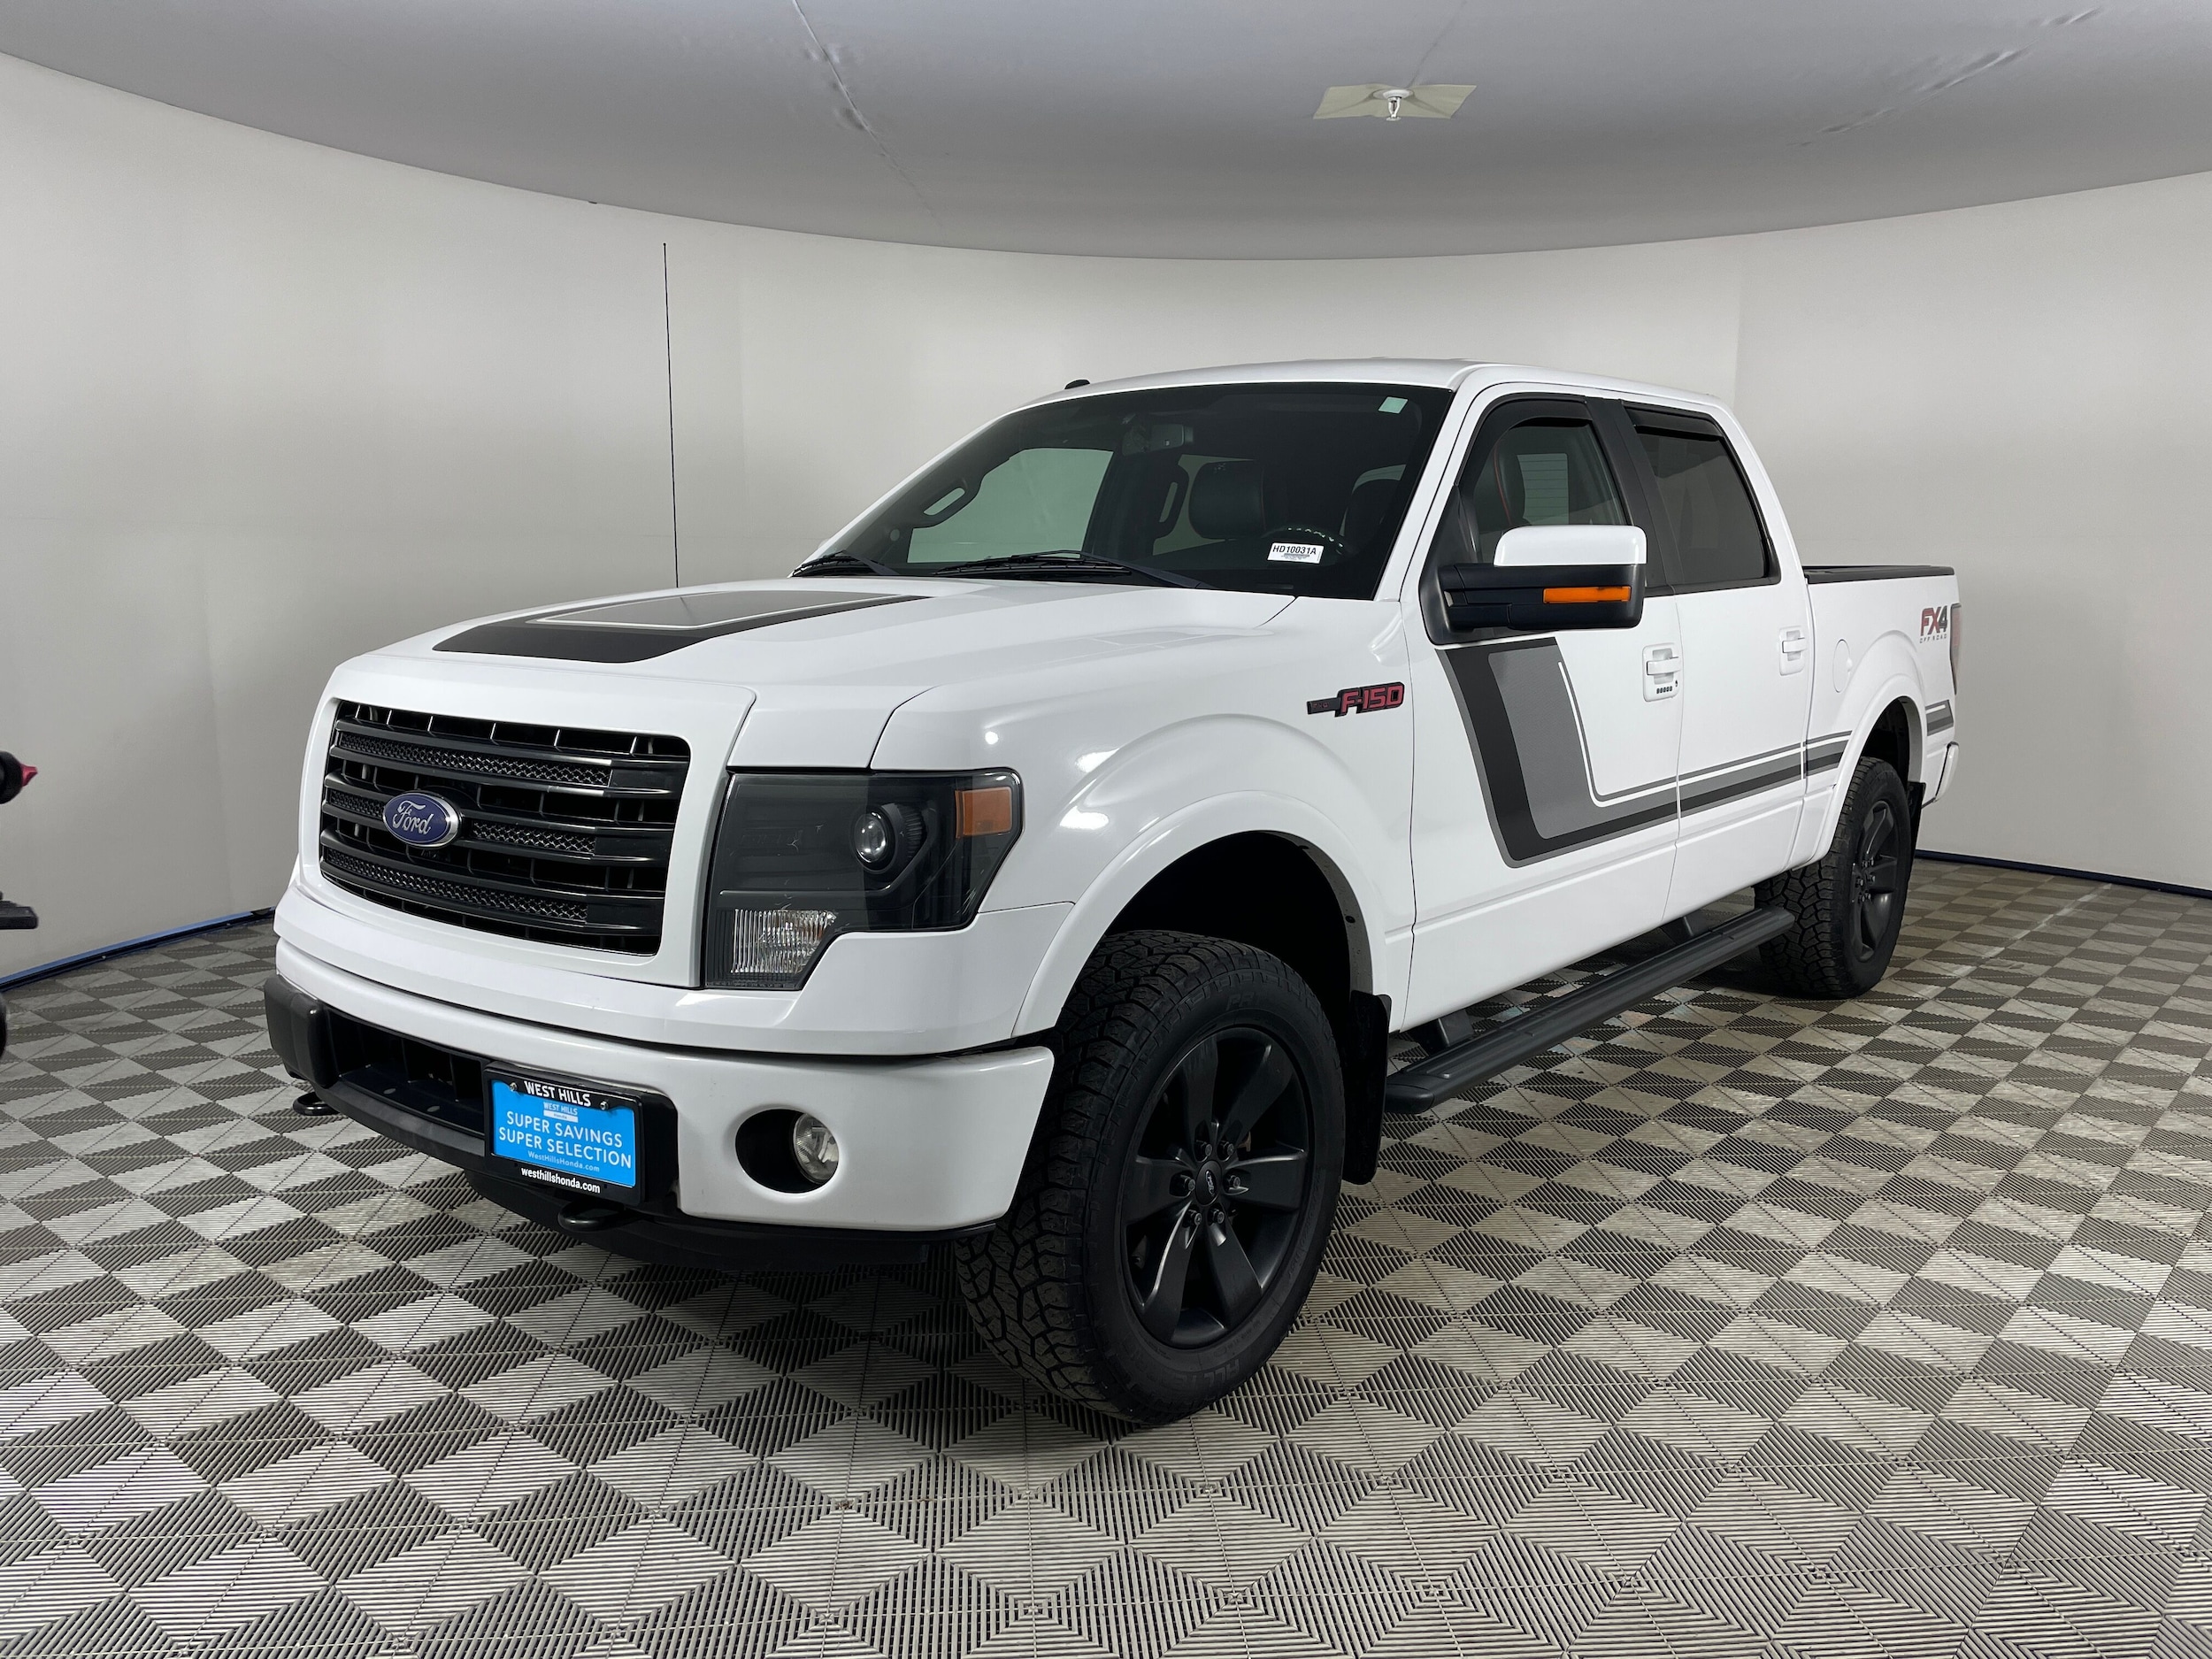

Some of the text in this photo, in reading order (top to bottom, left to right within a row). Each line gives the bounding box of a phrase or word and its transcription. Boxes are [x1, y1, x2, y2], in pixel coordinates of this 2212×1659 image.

[1272, 545, 1317, 555] HD10031A
[1920, 605, 1948, 636] FX4
[1340, 684, 1403, 714] F-150
[392, 800, 434, 835] Ford
[524, 1080, 592, 1107] WEST HILLS
[543, 1102, 578, 1116] WEST HILLS
[507, 1110, 623, 1148] SUPER SAVINGS
[499, 1126, 632, 1169] SUPER SELECTION
[527, 1150, 600, 1172] WestHillsHonda.com
[521, 1167, 601, 1194] westhillshonda.com
